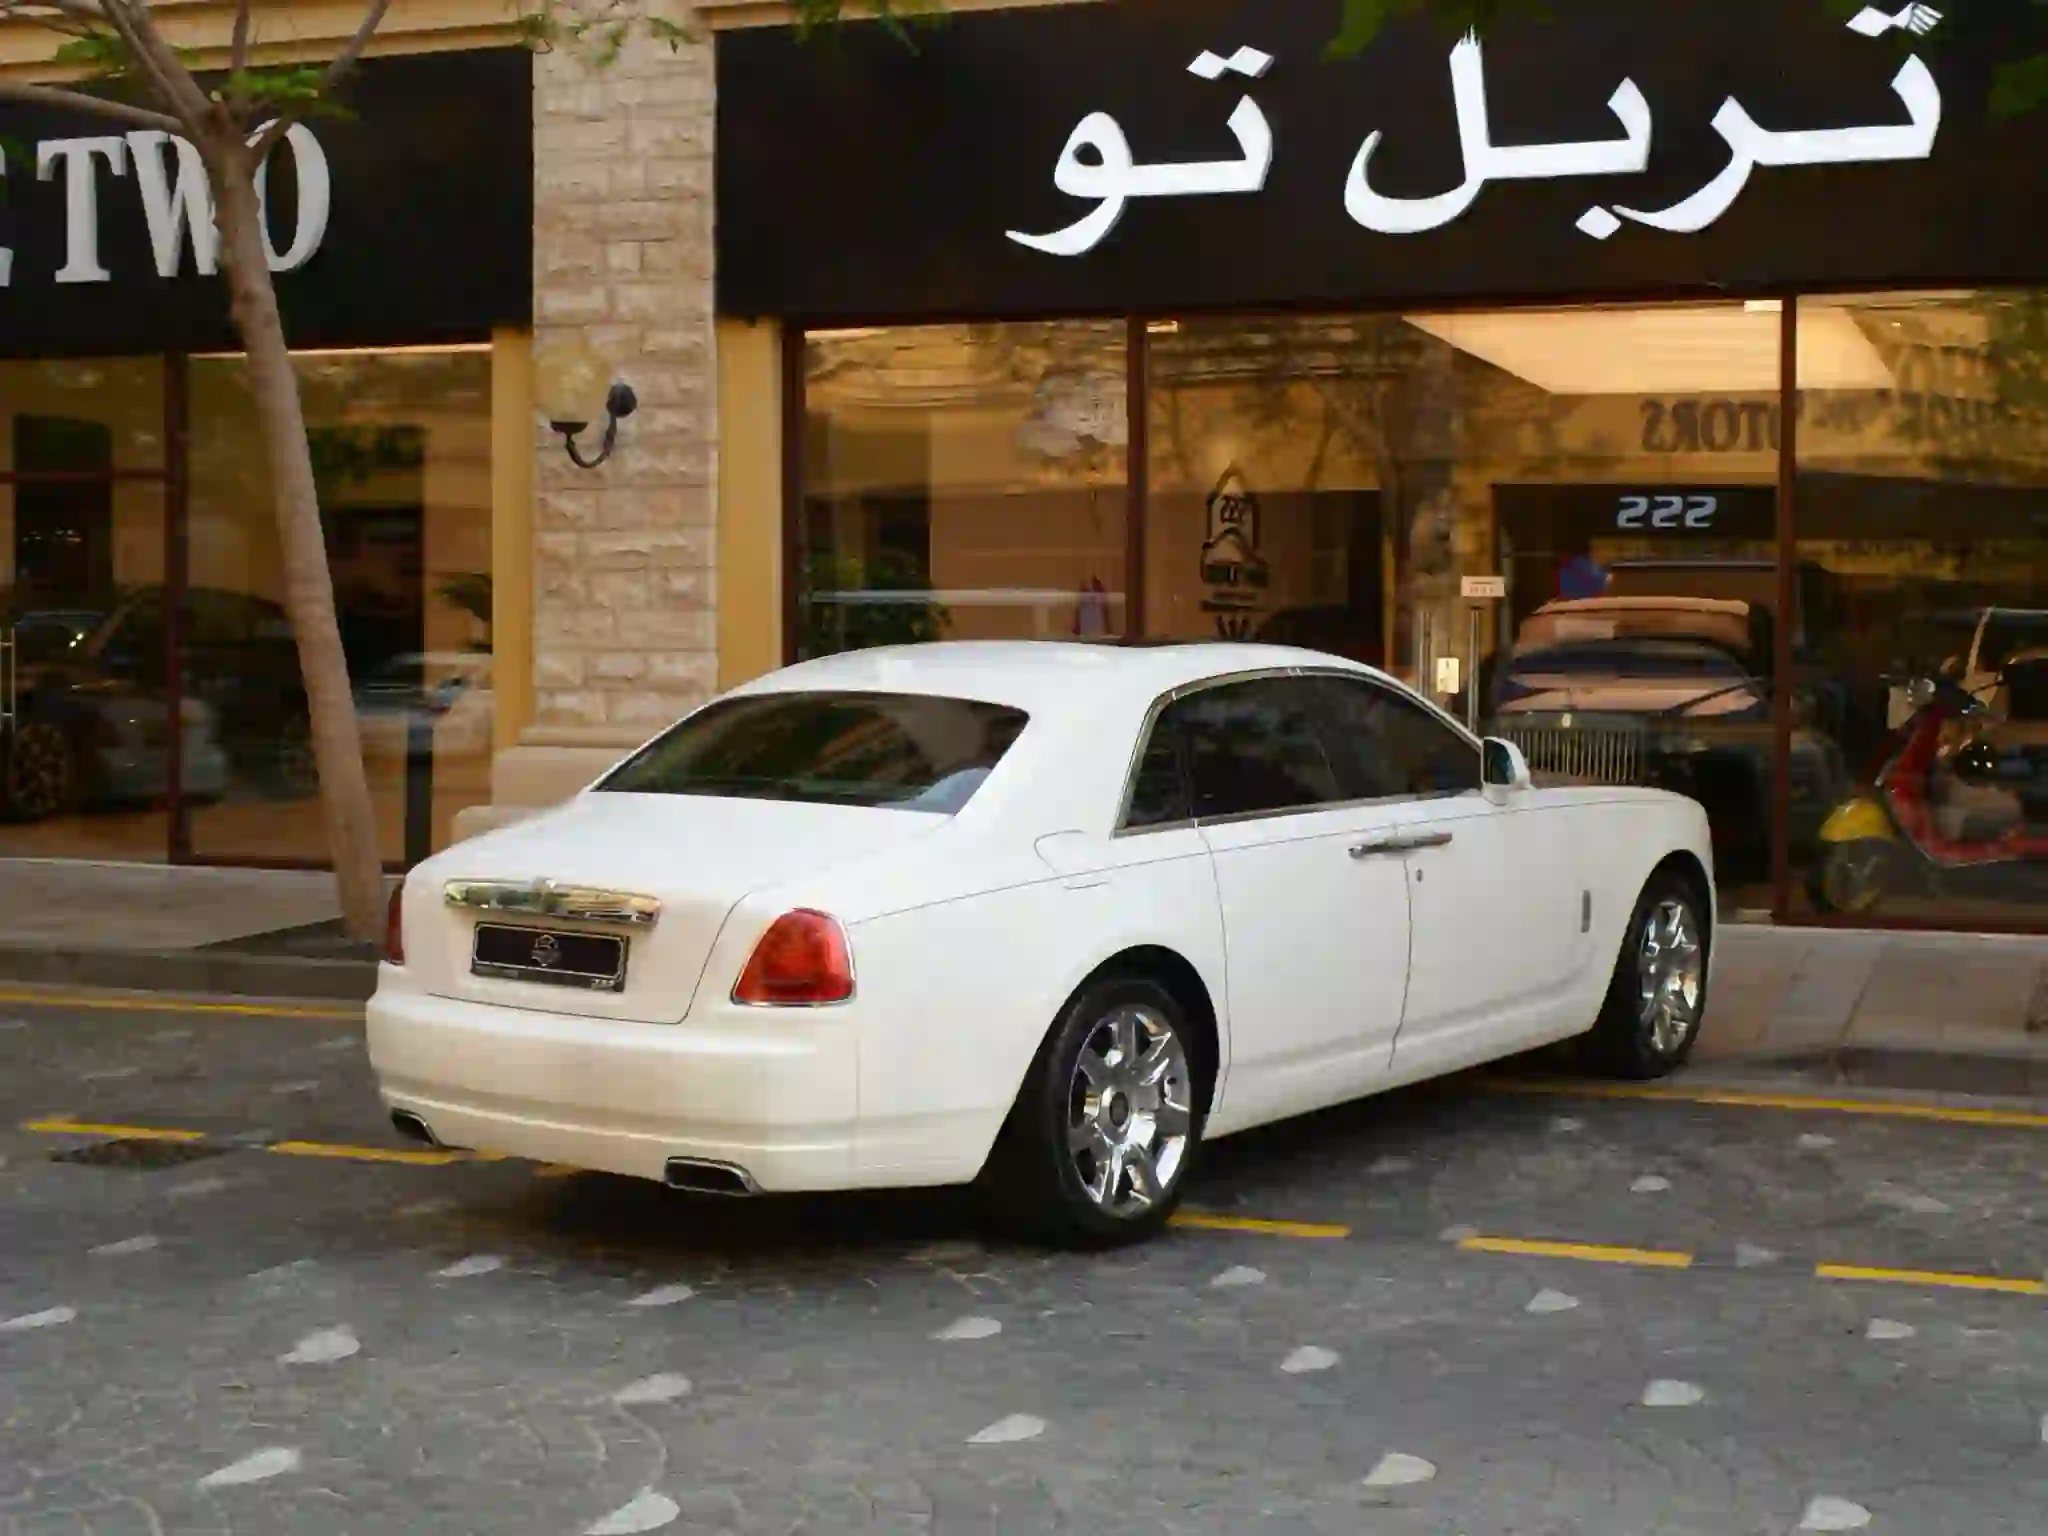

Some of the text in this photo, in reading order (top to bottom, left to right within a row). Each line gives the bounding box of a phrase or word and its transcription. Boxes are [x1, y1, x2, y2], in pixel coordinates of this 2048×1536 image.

[37, 118, 330, 283] TWO
[1005, 2, 1945, 256] تربل تو
